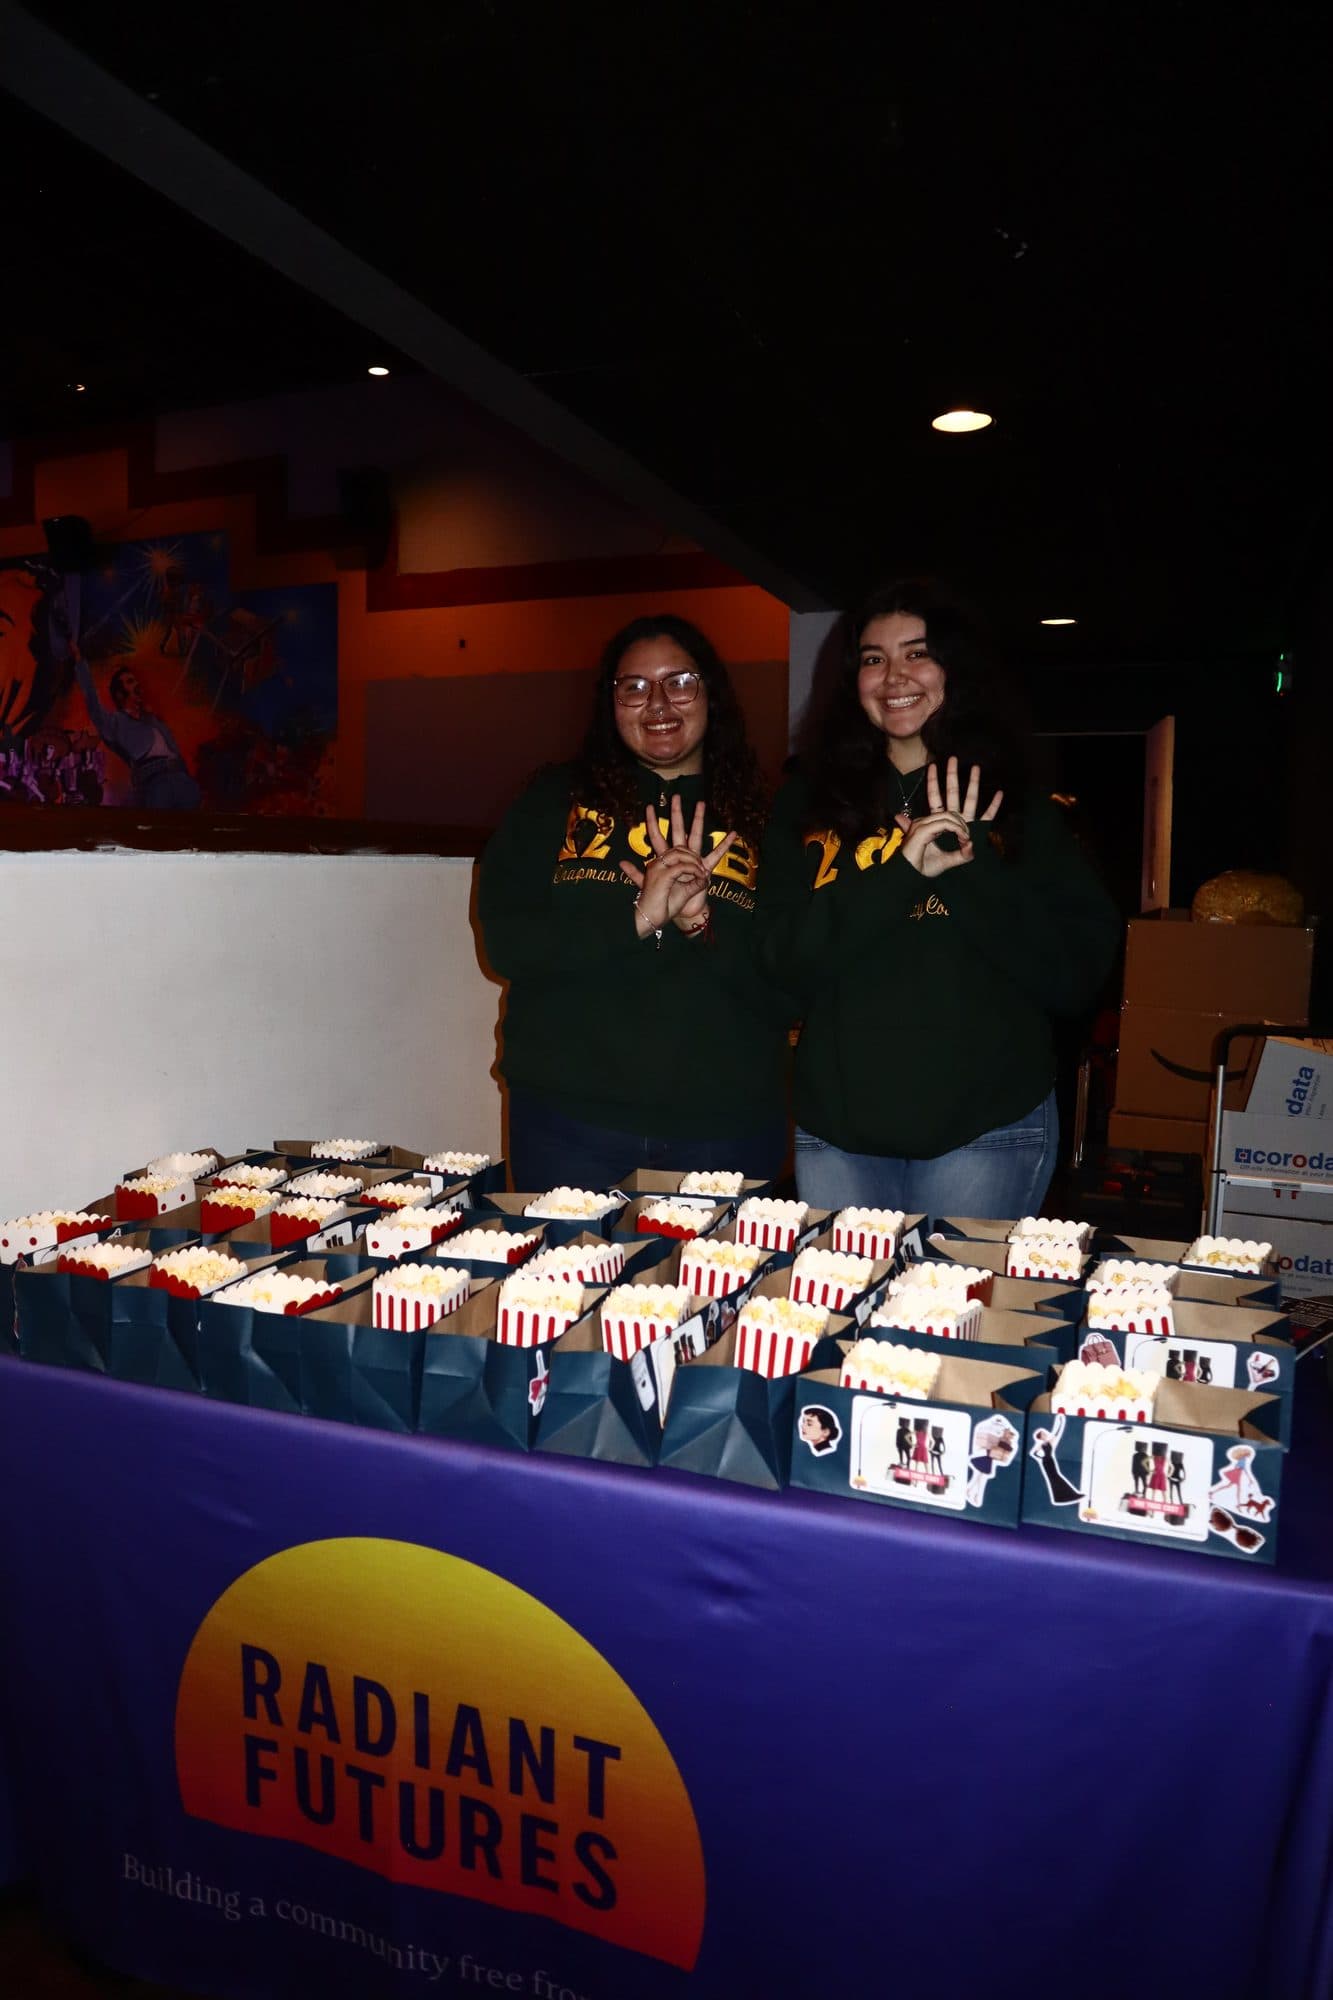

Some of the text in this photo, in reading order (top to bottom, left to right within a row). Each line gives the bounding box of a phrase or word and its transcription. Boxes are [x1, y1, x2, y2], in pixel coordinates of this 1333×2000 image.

[1286, 1066, 1314, 1117] data
[240, 1642, 621, 1820] RADIANT
[244, 1733, 619, 1912] FUTURES
[121, 1853, 592, 2000] Building a community free fro
